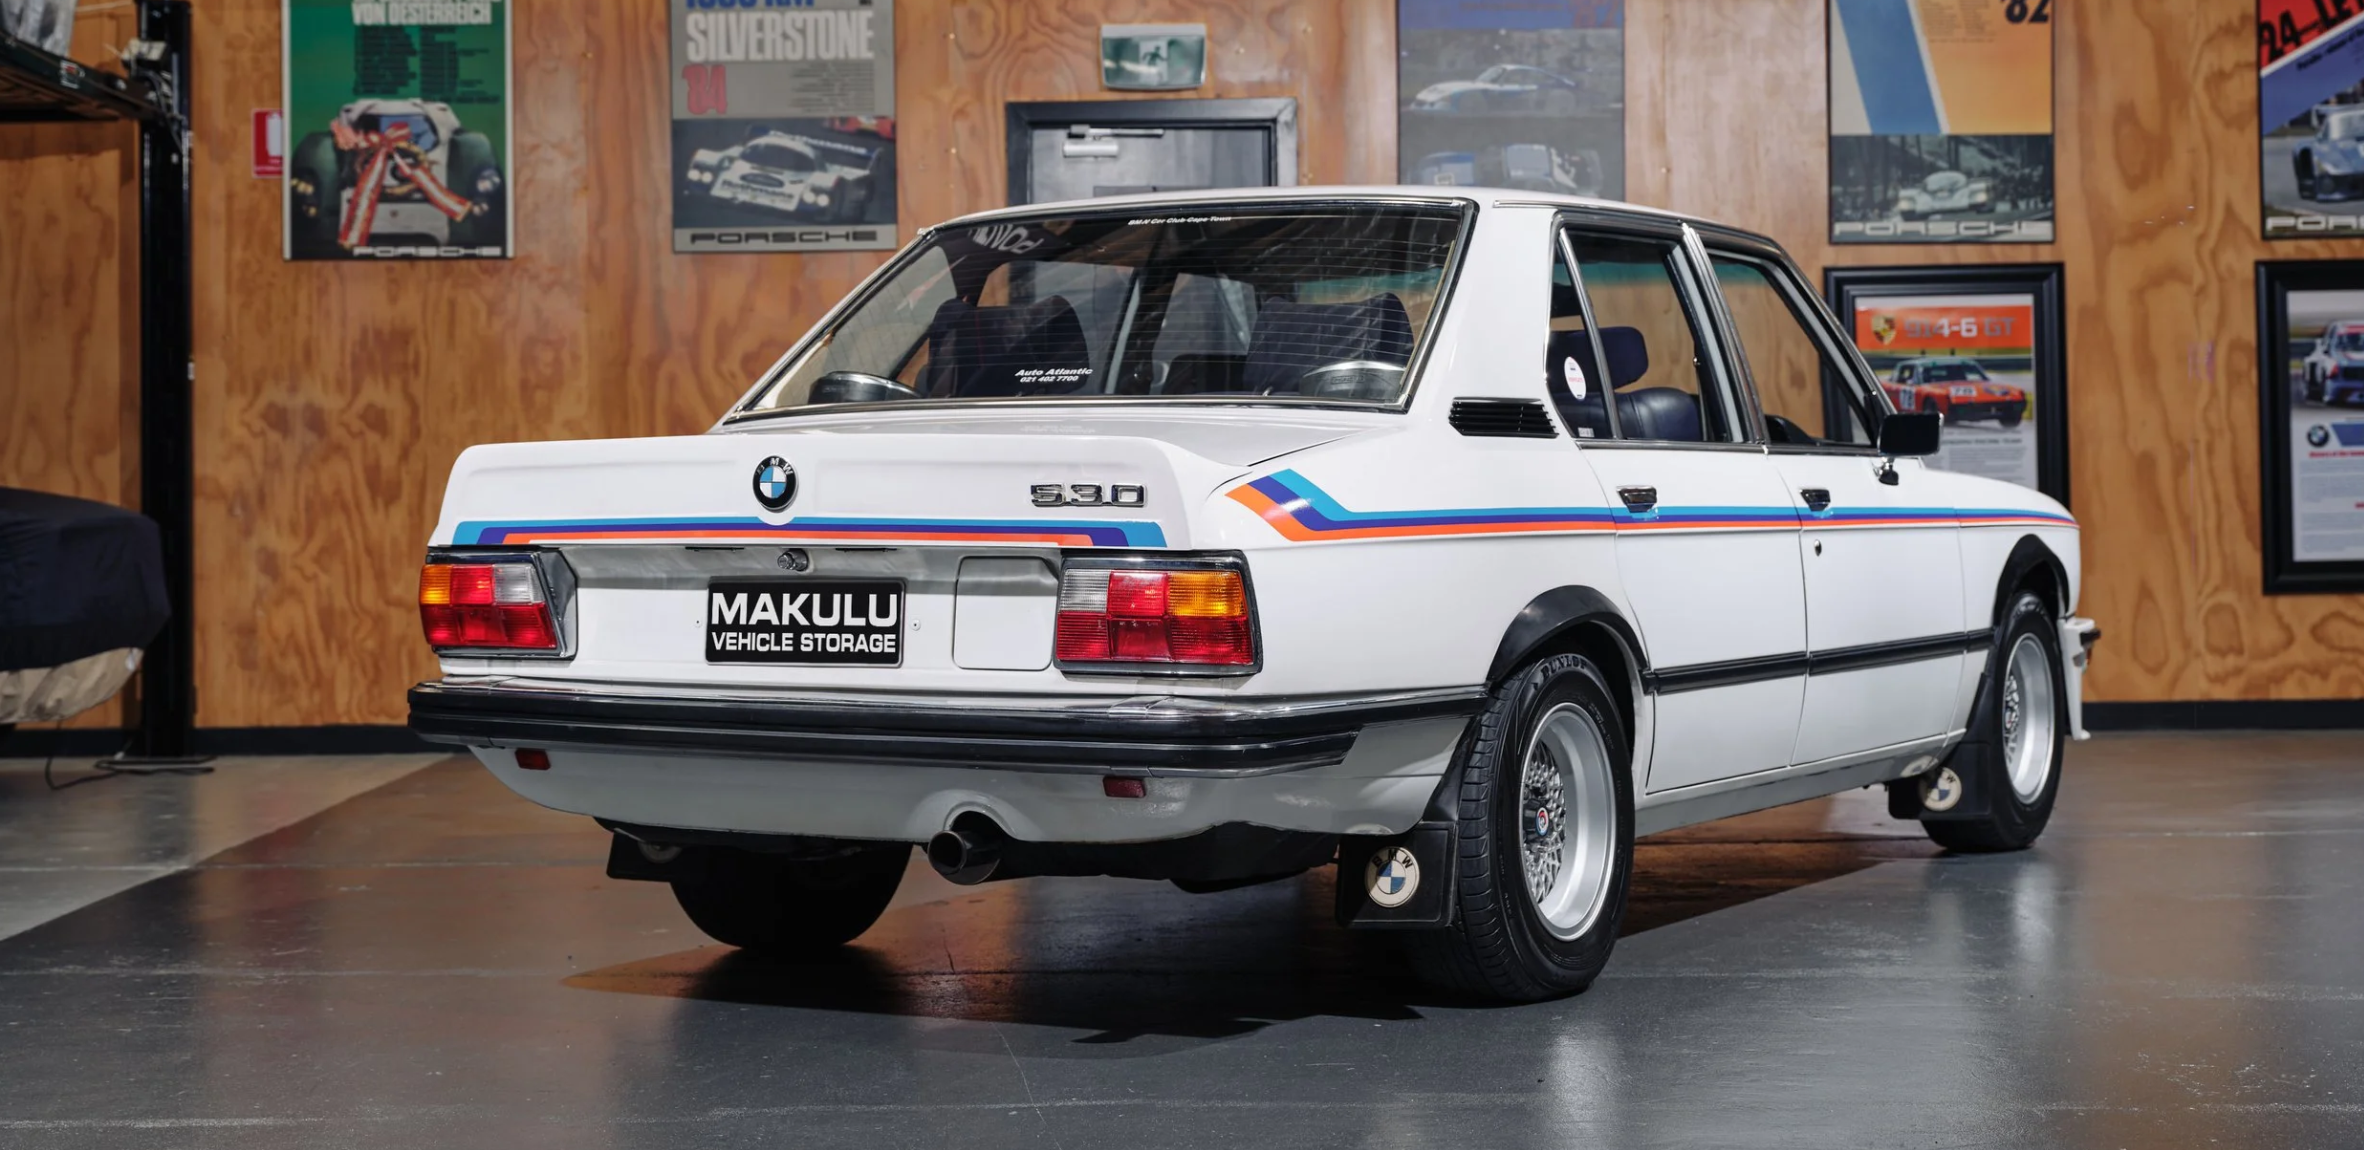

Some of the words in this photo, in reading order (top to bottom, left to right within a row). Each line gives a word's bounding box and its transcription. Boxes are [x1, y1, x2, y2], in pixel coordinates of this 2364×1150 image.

[352, 1, 387, 25] VON
[388, 1, 492, 25] OESTERREICH
[686, 10, 875, 62] SILVERSTONE
[690, 231, 877, 244] PORSCHE
[1834, 221, 2053, 236] PORSCHE
[353, 246, 502, 258] PORSCHE
[1905, 317, 1978, 338] 914-6
[1984, 316, 2016, 337] GT
[1015, 369, 1044, 377] Auto
[1045, 367, 1093, 376] Atlantic
[756, 457, 794, 475] BMW
[1030, 483, 1146, 508] 530
[711, 592, 898, 628] MAKULU
[711, 631, 794, 652] VEHICLE
[800, 633, 897, 653] STORAGE
[1540, 655, 1588, 680] DUNLOP
[1372, 848, 1413, 869] BMW
